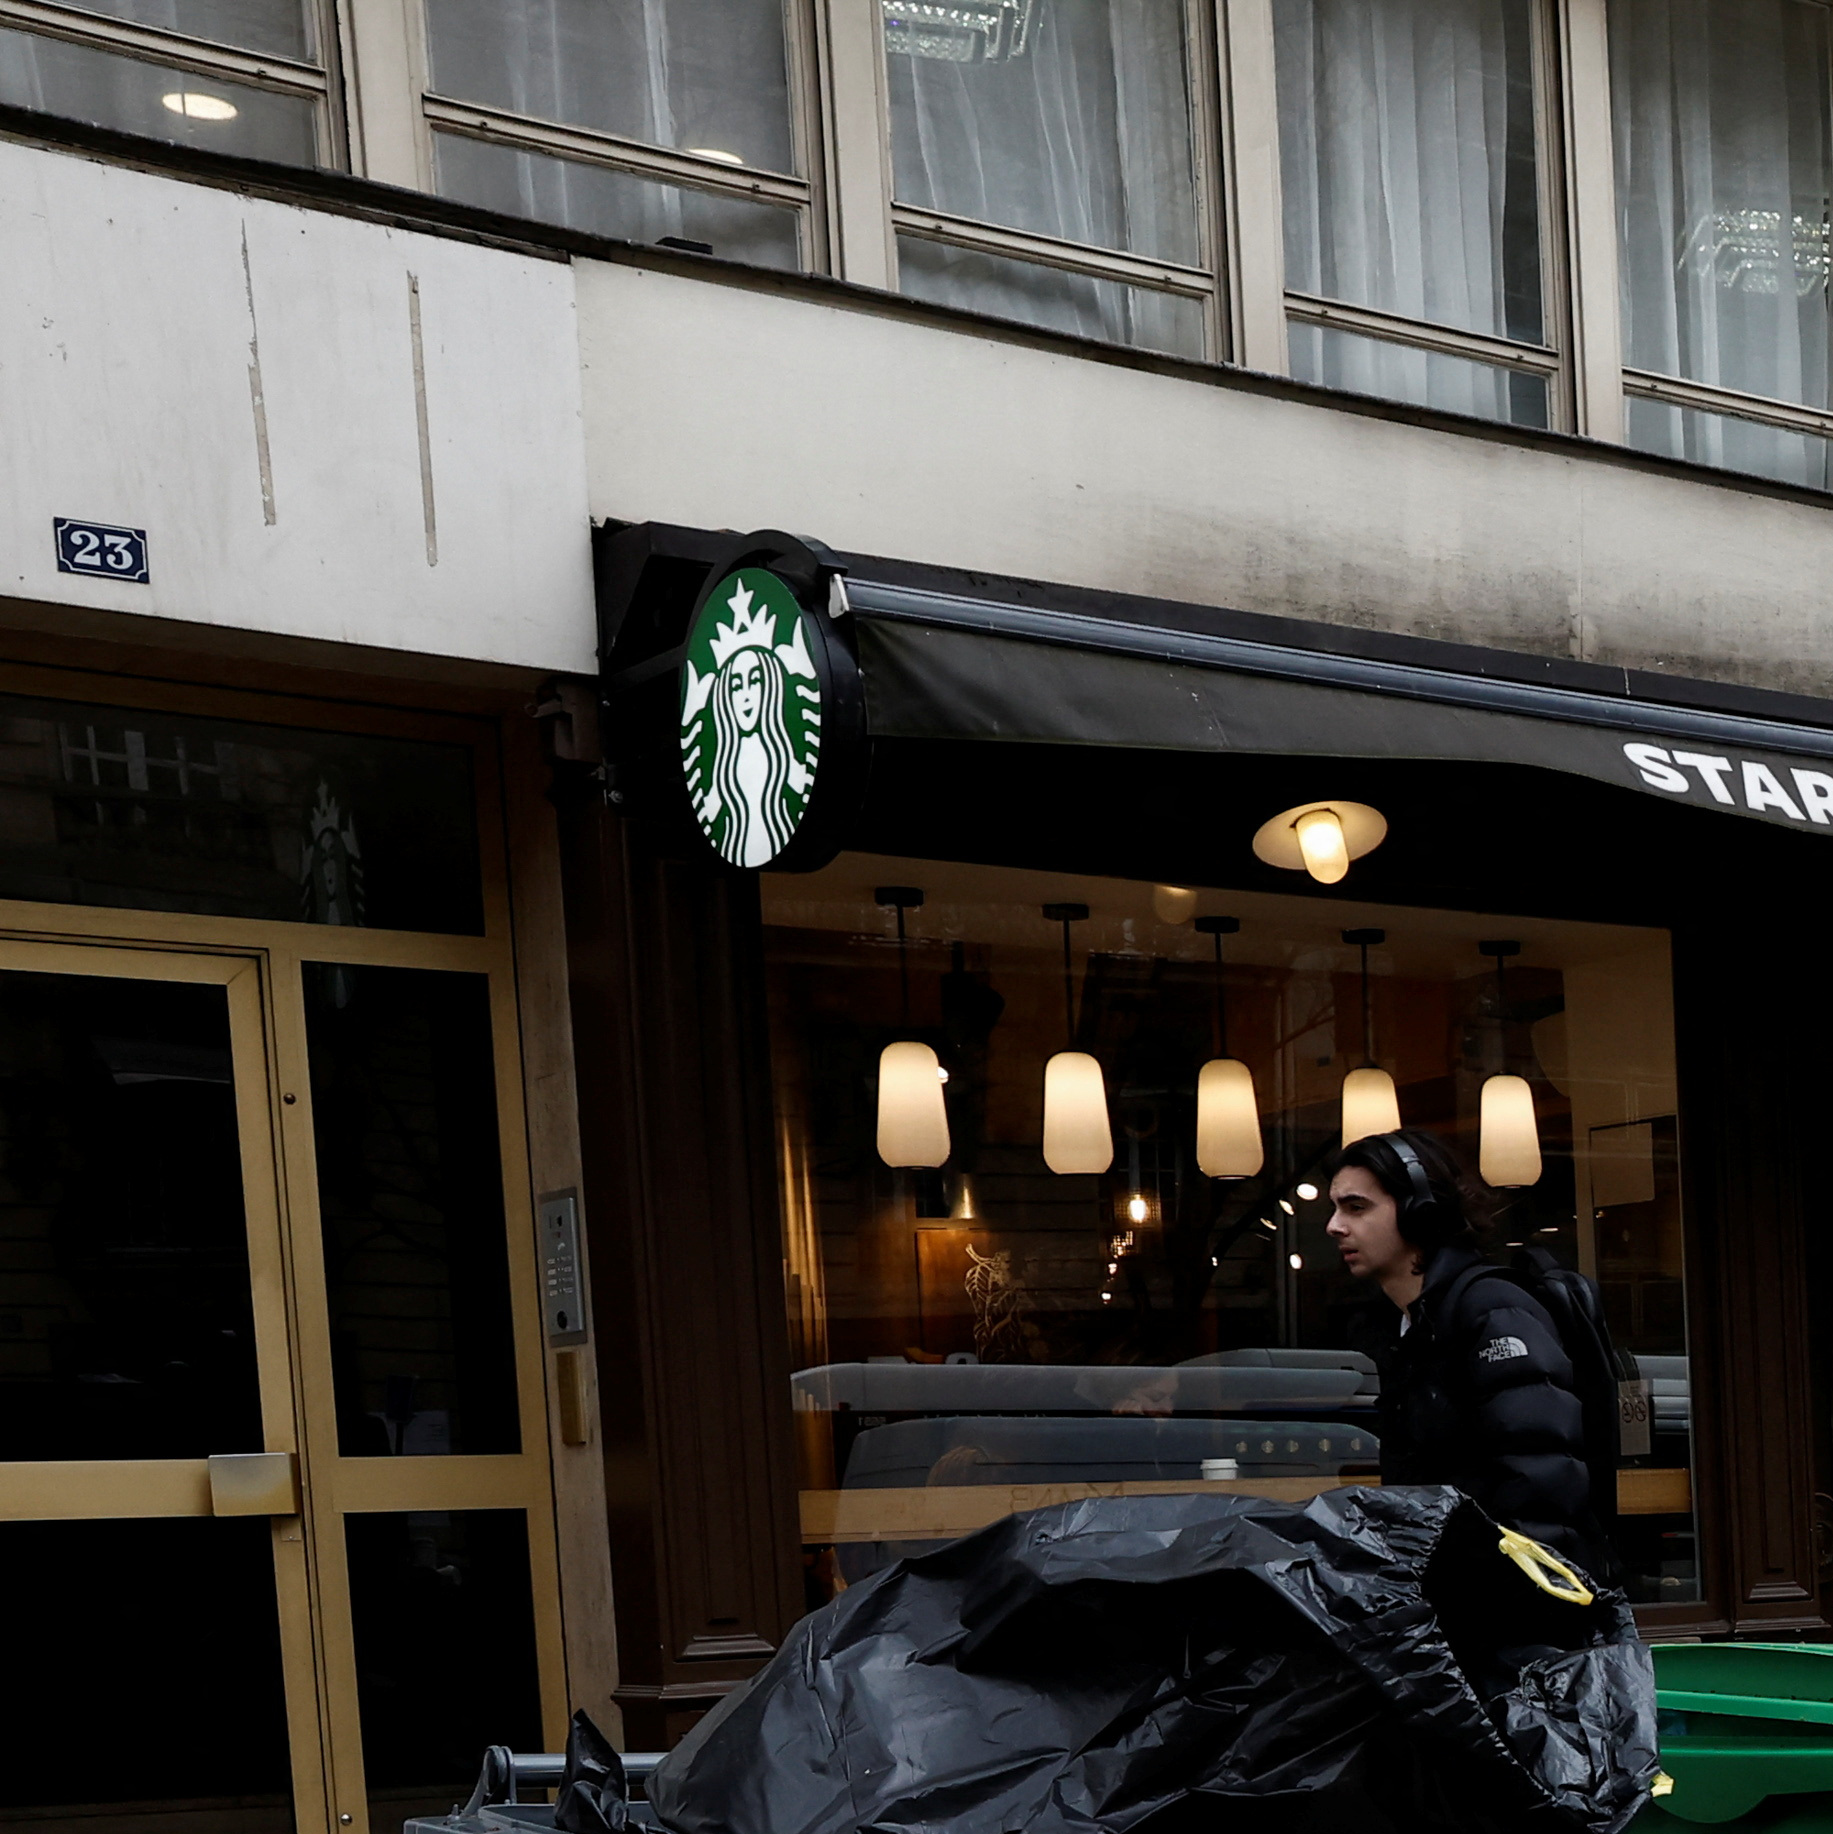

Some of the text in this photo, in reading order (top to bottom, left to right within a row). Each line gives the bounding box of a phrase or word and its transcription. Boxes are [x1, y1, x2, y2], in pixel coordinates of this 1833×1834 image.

[71, 530, 134, 571] 23
[1489, 1338, 1508, 1347] THE
[1479, 1346, 1509, 1359] NORTH
[1488, 1350, 1511, 1362] FACE
